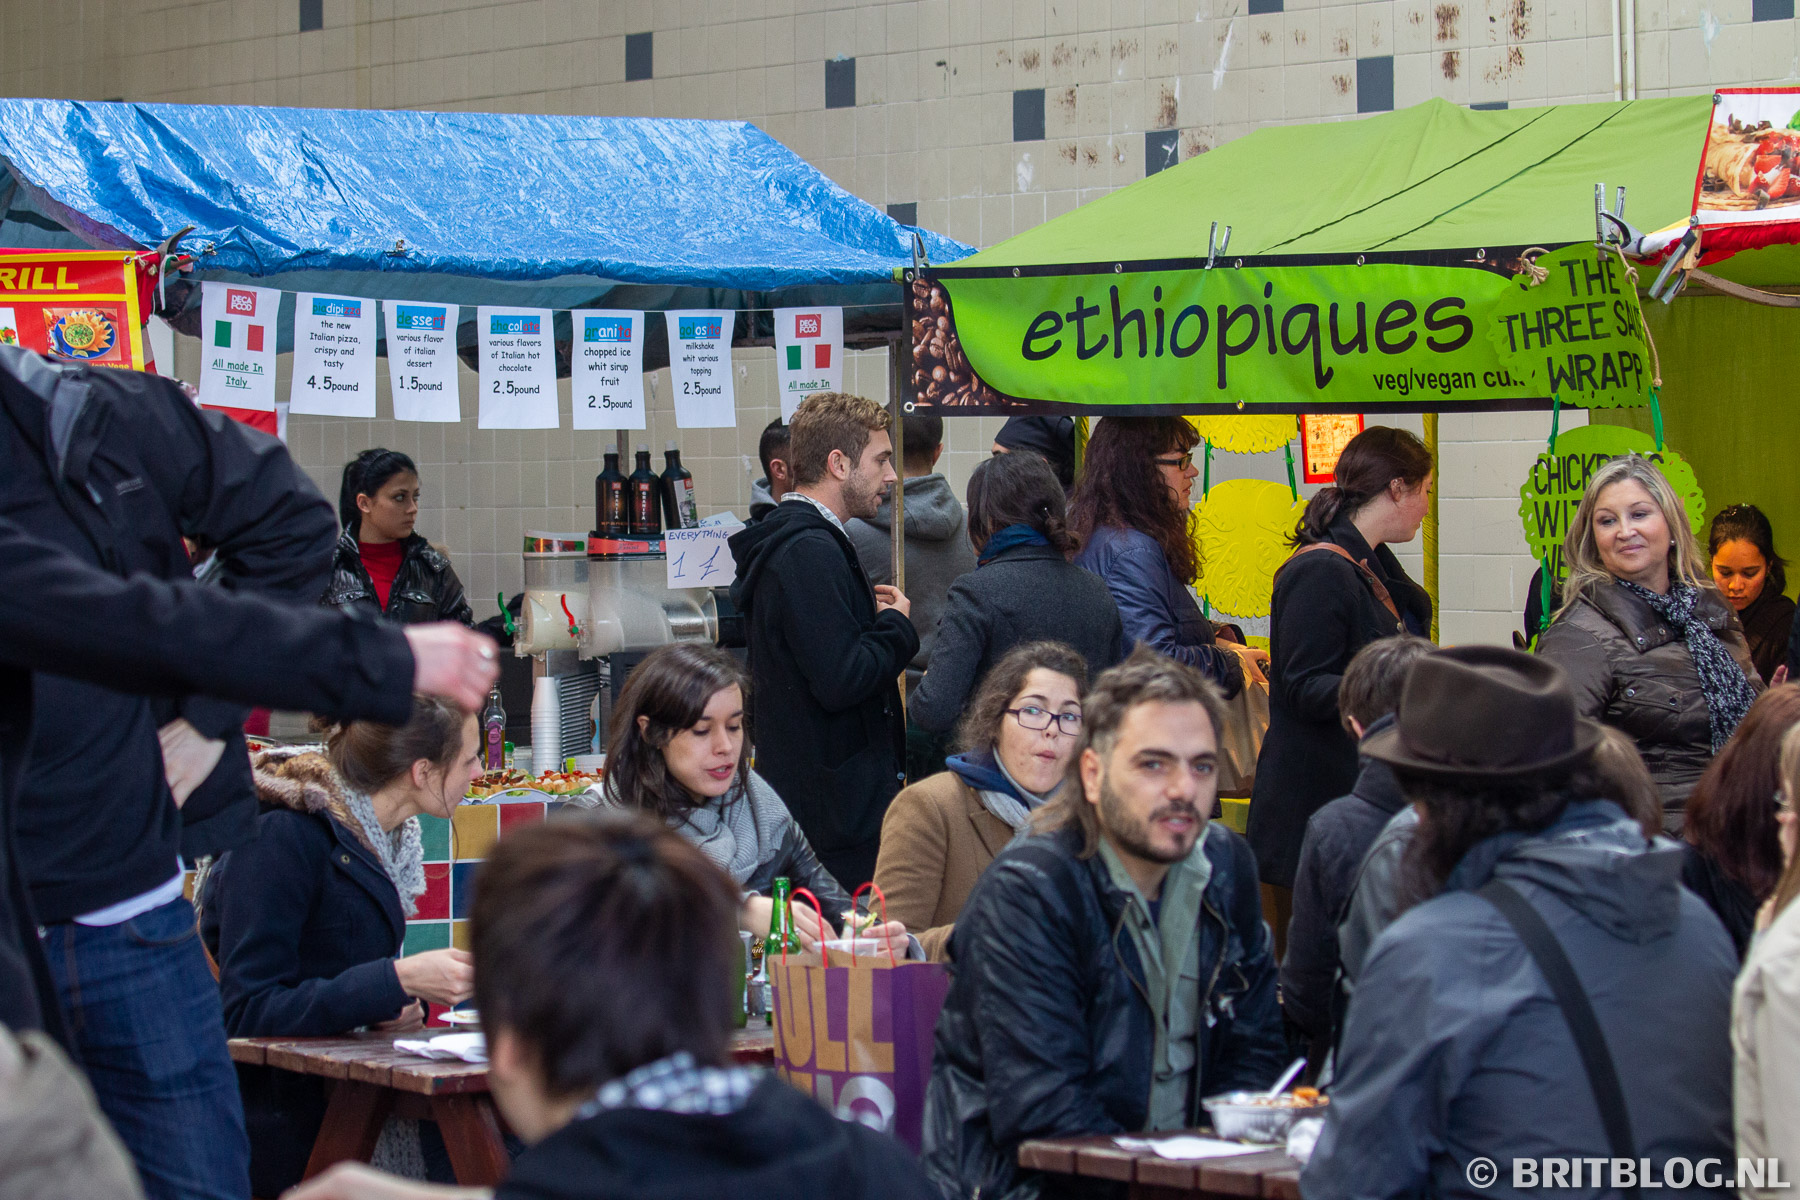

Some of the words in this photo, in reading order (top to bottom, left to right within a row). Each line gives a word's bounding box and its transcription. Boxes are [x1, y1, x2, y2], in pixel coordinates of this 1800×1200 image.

[1560, 257, 1621, 297] THE
[231, 295, 252, 304] DECA
[231, 303, 252, 312] FOOD
[312, 302, 361, 316] piadipizza
[397, 311, 446, 327] dessert
[799, 319, 818, 327] DECA
[321, 320, 334, 329] the
[336, 322, 352, 330] new
[490, 320, 541, 332] chocolate
[679, 319, 722, 335] golosito
[799, 326, 818, 334] FOOD
[1498, 301, 1612, 352] THREE
[584, 325, 632, 339] granita
[1021, 281, 1474, 390] ethiopiques
[310, 332, 336, 342] Italian
[337, 335, 361, 345] pizza,
[396, 334, 421, 343] various
[423, 333, 444, 343] flavor
[489, 339, 514, 347] various
[517, 338, 542, 347] flavors
[314, 345, 338, 356] crispy
[340, 347, 355, 356] and
[404, 346, 412, 355] of
[685, 342, 715, 350] milkshake
[491, 351, 498, 359] of
[584, 347, 617, 358] chopped
[620, 348, 631, 356] ice
[682, 354, 695, 362] whit
[698, 354, 719, 362] various
[212, 358, 224, 368] All
[227, 362, 249, 372] made
[252, 363, 263, 373] In
[323, 360, 344, 370] tasty
[407, 359, 432, 368] dessert
[498, 364, 532, 372] chocolate
[588, 362, 607, 371] whit
[610, 363, 629, 374] sirup
[690, 367, 712, 376] topping
[1546, 350, 1643, 394] WRAPP
[225, 376, 248, 389] Italy
[600, 377, 620, 386] fruit
[788, 380, 797, 390] All
[799, 380, 818, 389] made
[820, 379, 830, 388] In
[1373, 367, 1476, 396] veg/vegan
[668, 530, 729, 542] EVERYTHING
[672, 551, 686, 578] 1
